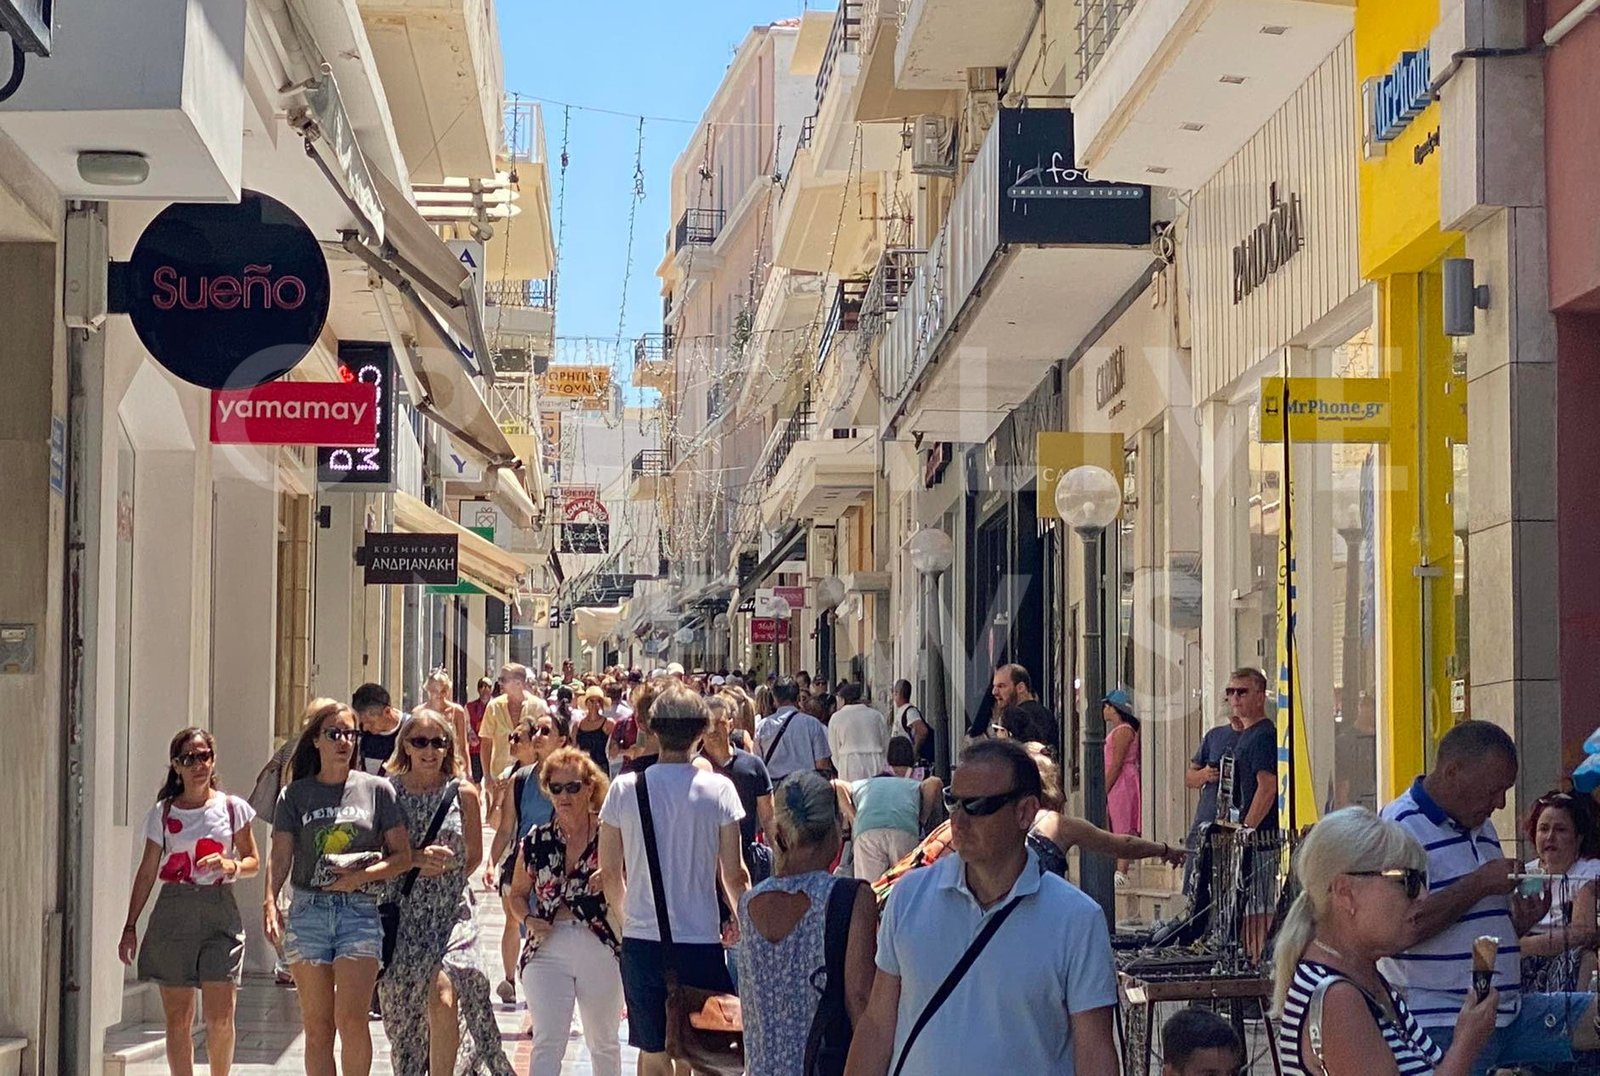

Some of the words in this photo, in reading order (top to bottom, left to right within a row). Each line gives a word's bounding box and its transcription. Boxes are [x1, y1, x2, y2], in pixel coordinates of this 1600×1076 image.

[1233, 191, 1304, 305] PANDORA
[153, 264, 306, 310] Sueño
[217, 399, 367, 425] yamamay
[1287, 399, 1383, 417] MrPhone.gr
[374, 545, 455, 553] ΚΟΣΜΗΜΑΤΑ
[371, 557, 455, 571] ΑΝΔΡΙΑΝΑΚΗ
[302, 806, 371, 826] LEMON
